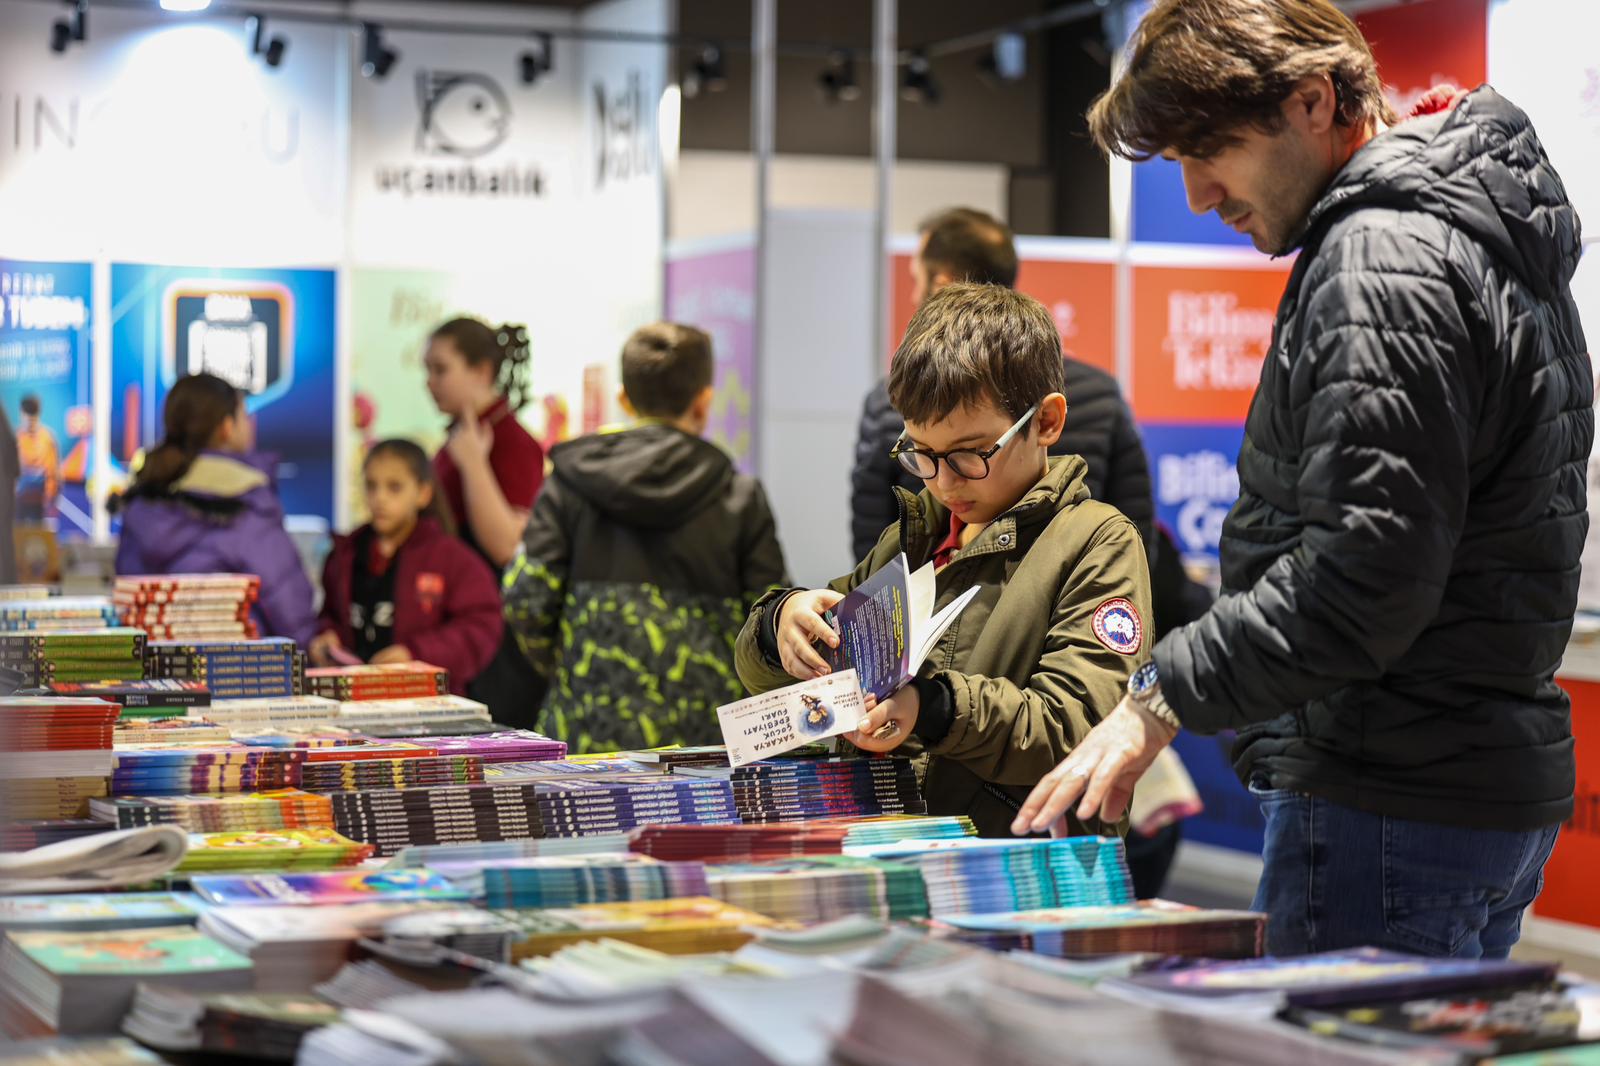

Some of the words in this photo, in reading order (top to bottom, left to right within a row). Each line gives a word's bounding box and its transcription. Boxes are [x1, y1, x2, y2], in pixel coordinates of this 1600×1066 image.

[761, 708, 788, 721] FUARI
[744, 716, 790, 736] EDEBİYATI
[763, 725, 792, 740] ÇOCUK
[754, 733, 795, 751] SAKARYA
